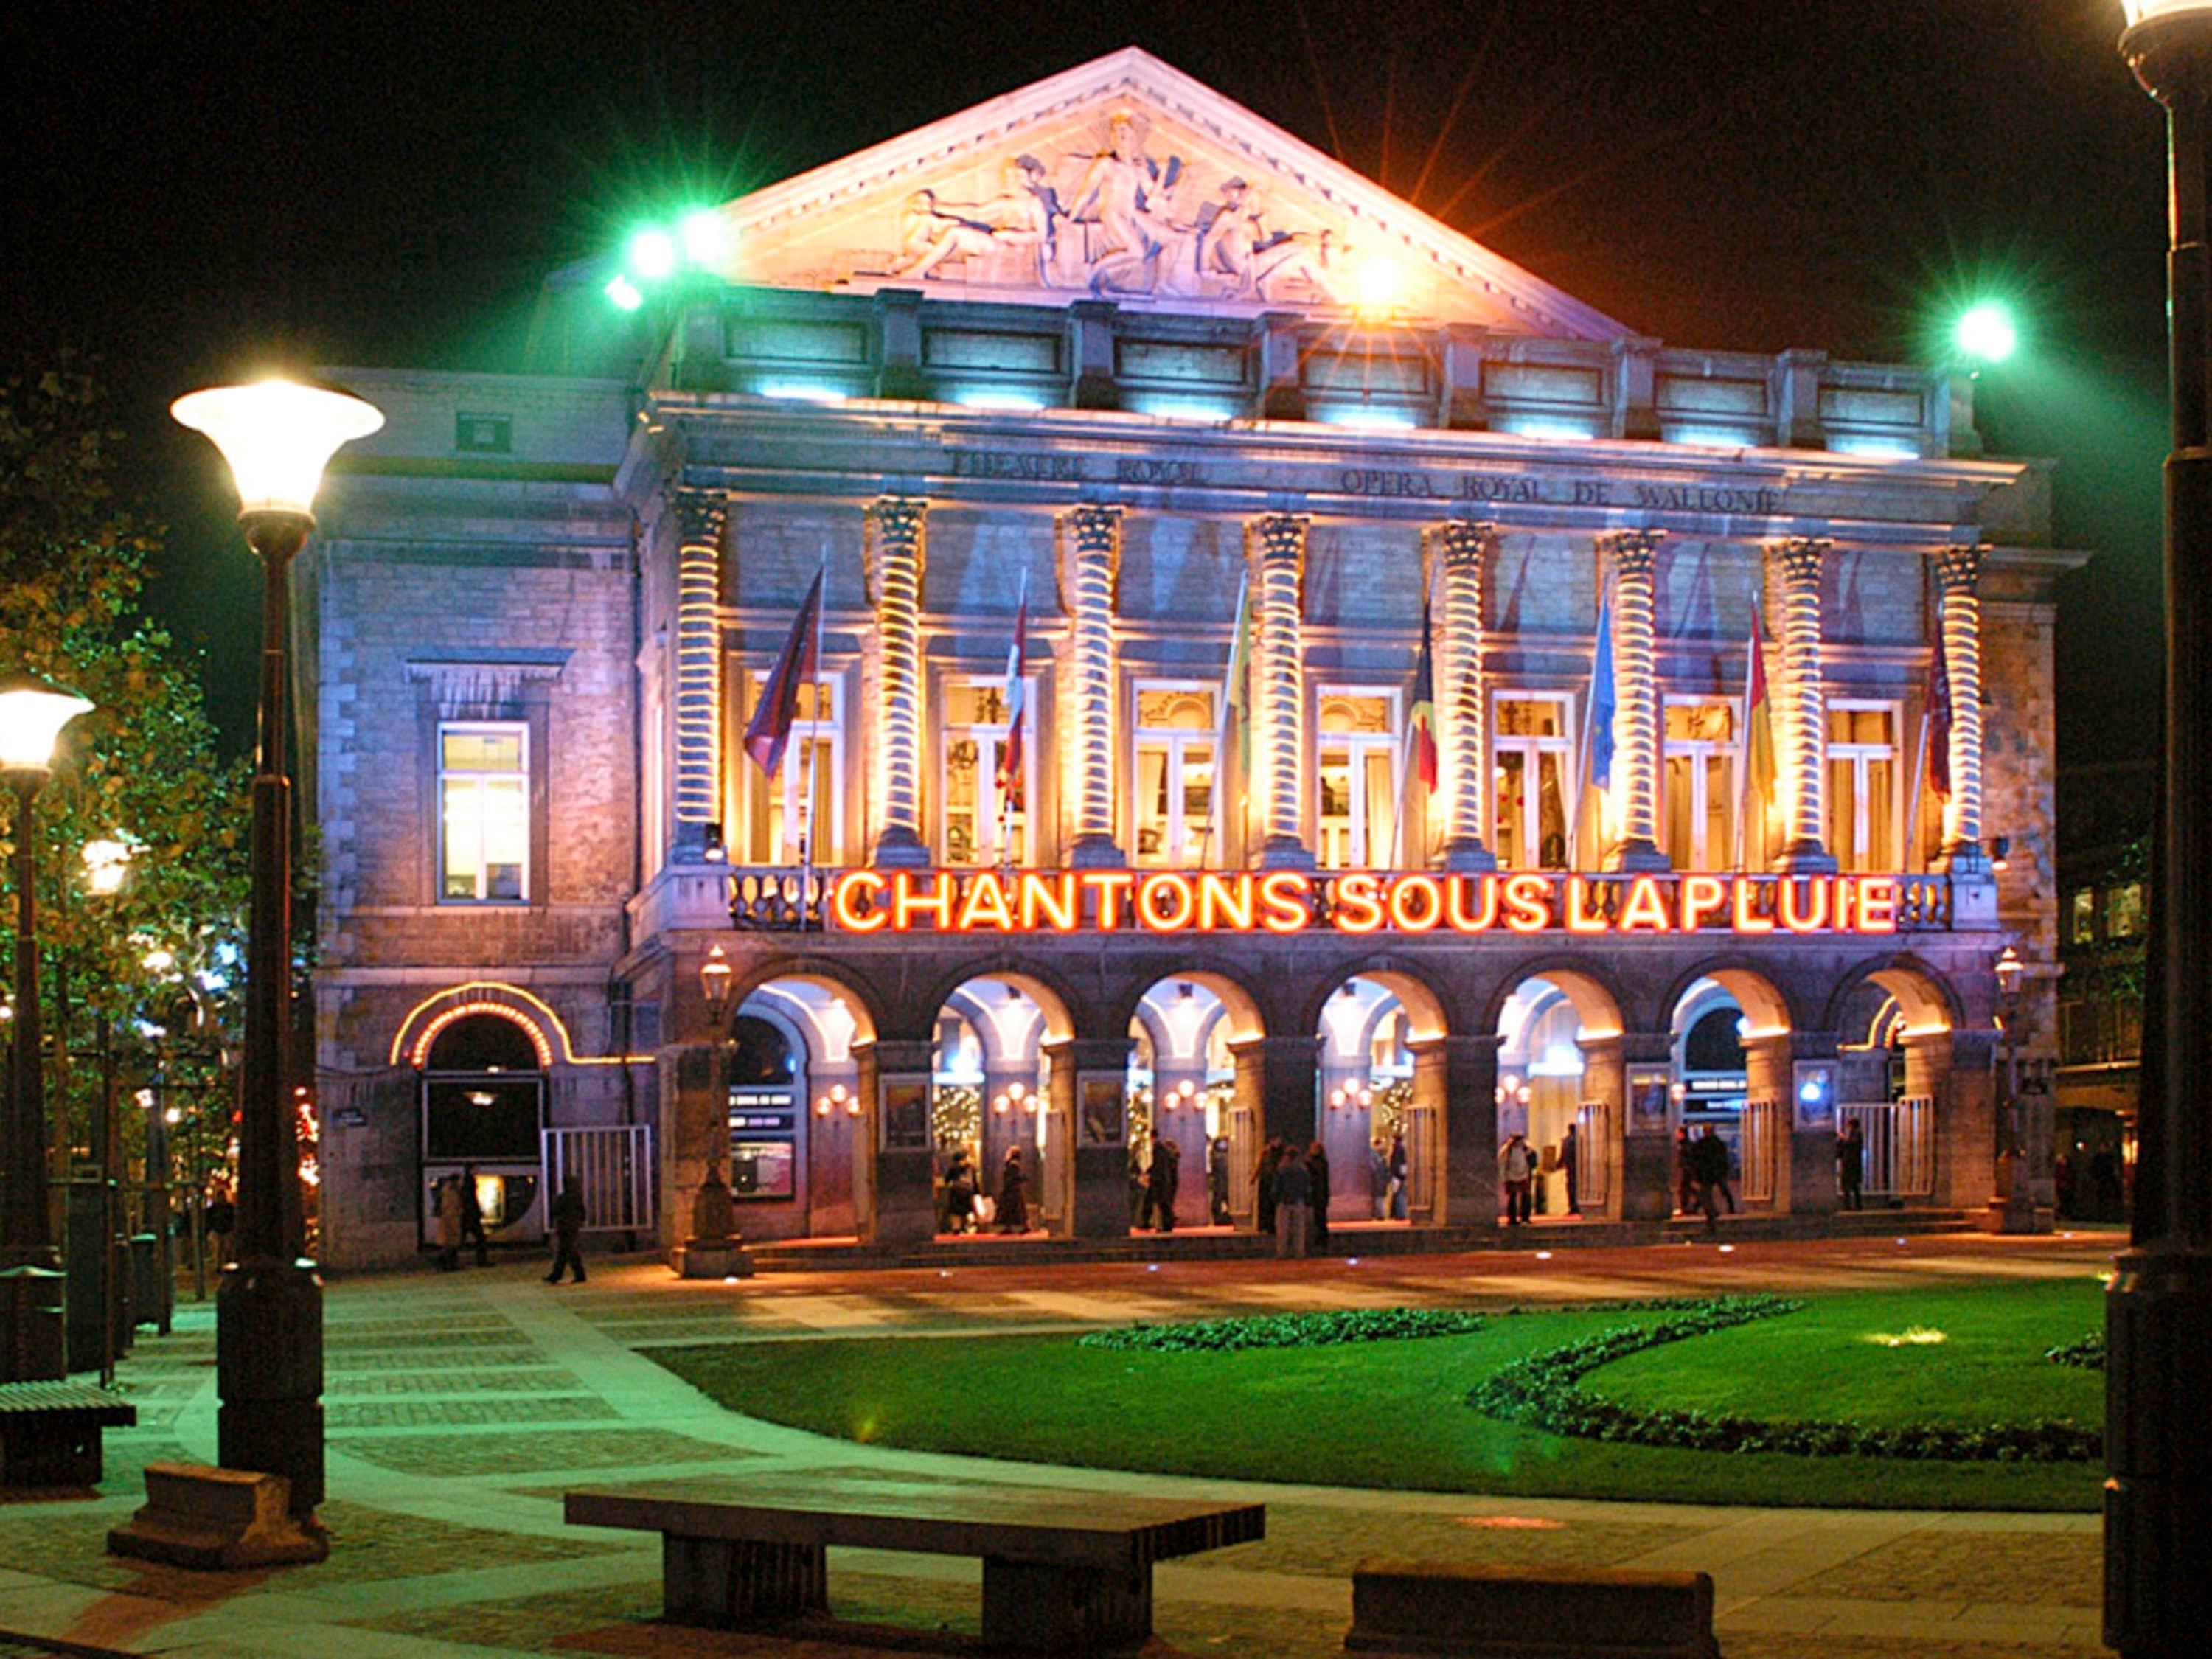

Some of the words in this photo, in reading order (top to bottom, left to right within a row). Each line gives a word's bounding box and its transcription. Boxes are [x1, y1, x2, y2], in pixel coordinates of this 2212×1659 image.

[1116, 459, 1206, 486] ROYAL
[1340, 470, 1436, 498] OPERA
[1461, 475, 1547, 503] ROYAL
[1573, 480, 1612, 506] DE
[1635, 483, 1783, 515] WALLONIE
[833, 869, 1311, 932] CHANTONS
